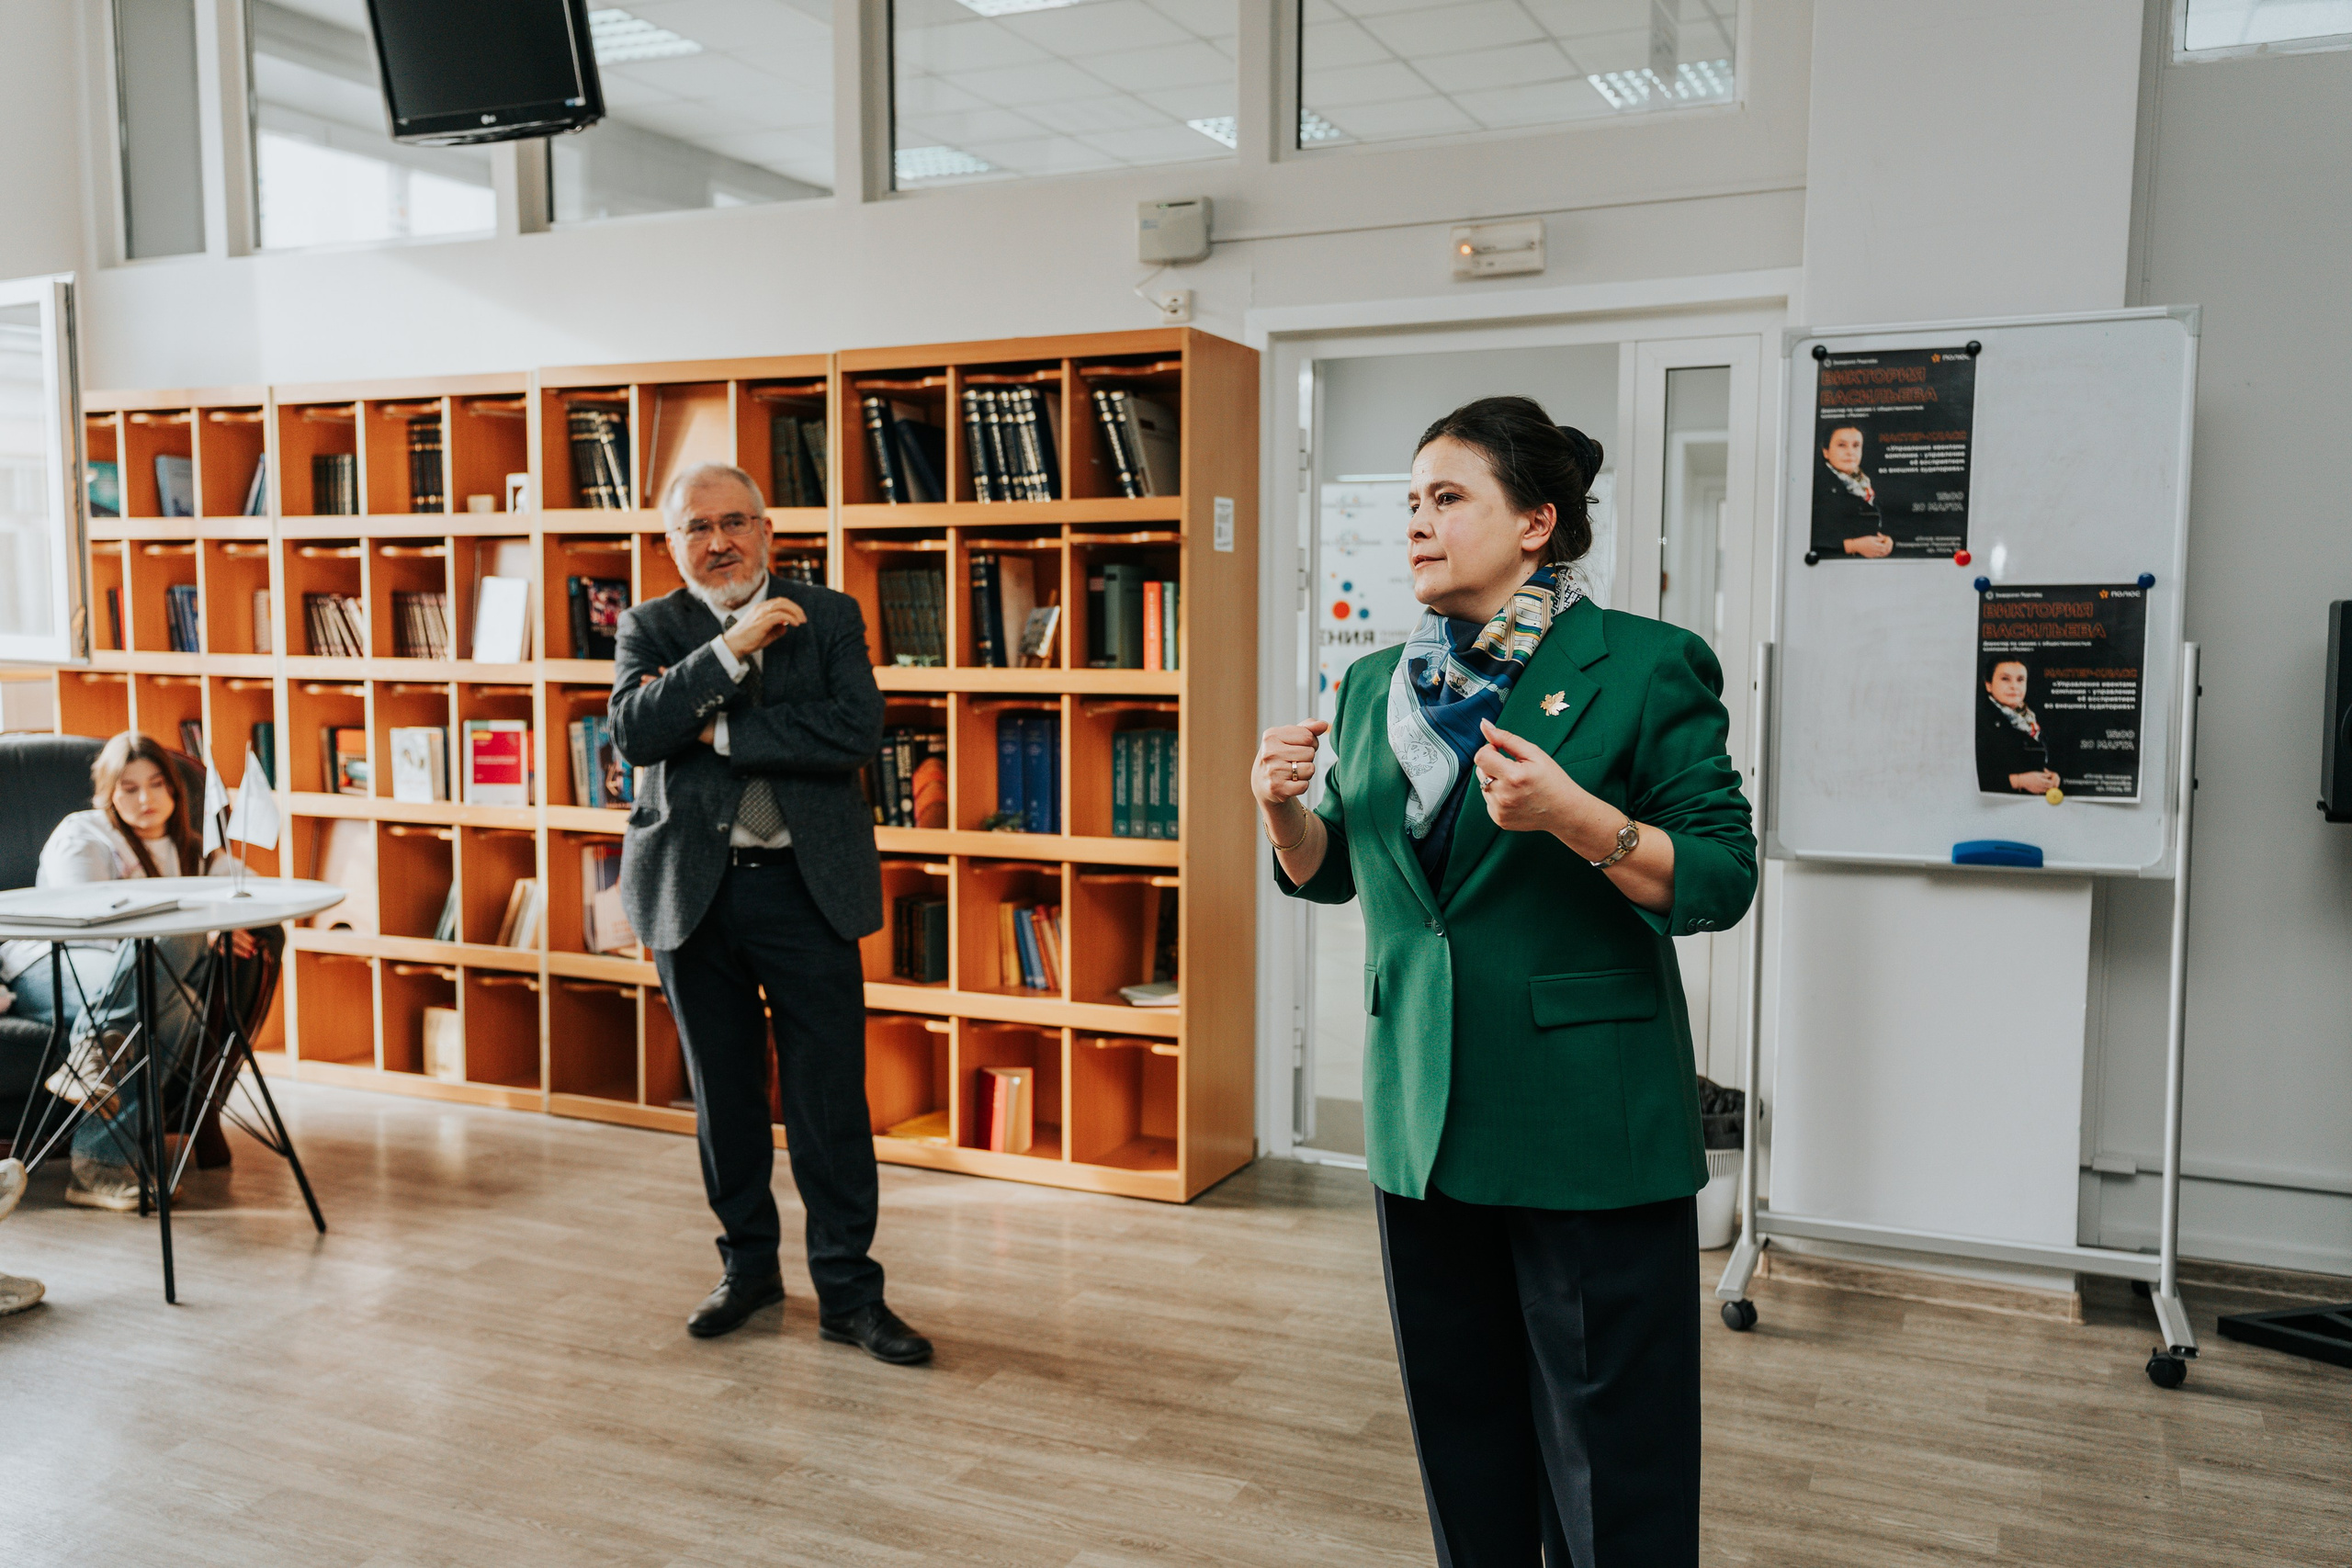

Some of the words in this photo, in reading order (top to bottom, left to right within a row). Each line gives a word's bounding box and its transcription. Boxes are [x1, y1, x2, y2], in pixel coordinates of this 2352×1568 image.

[1821, 367, 1927, 386] ВИКТОРИЯ
[1820, 386, 1939, 406] ВАСИЛЬЕВА
[1983, 602, 2094, 619] ВИКТОРИЯ
[1982, 622, 2107, 639] ВАСИЛЬЕВА
